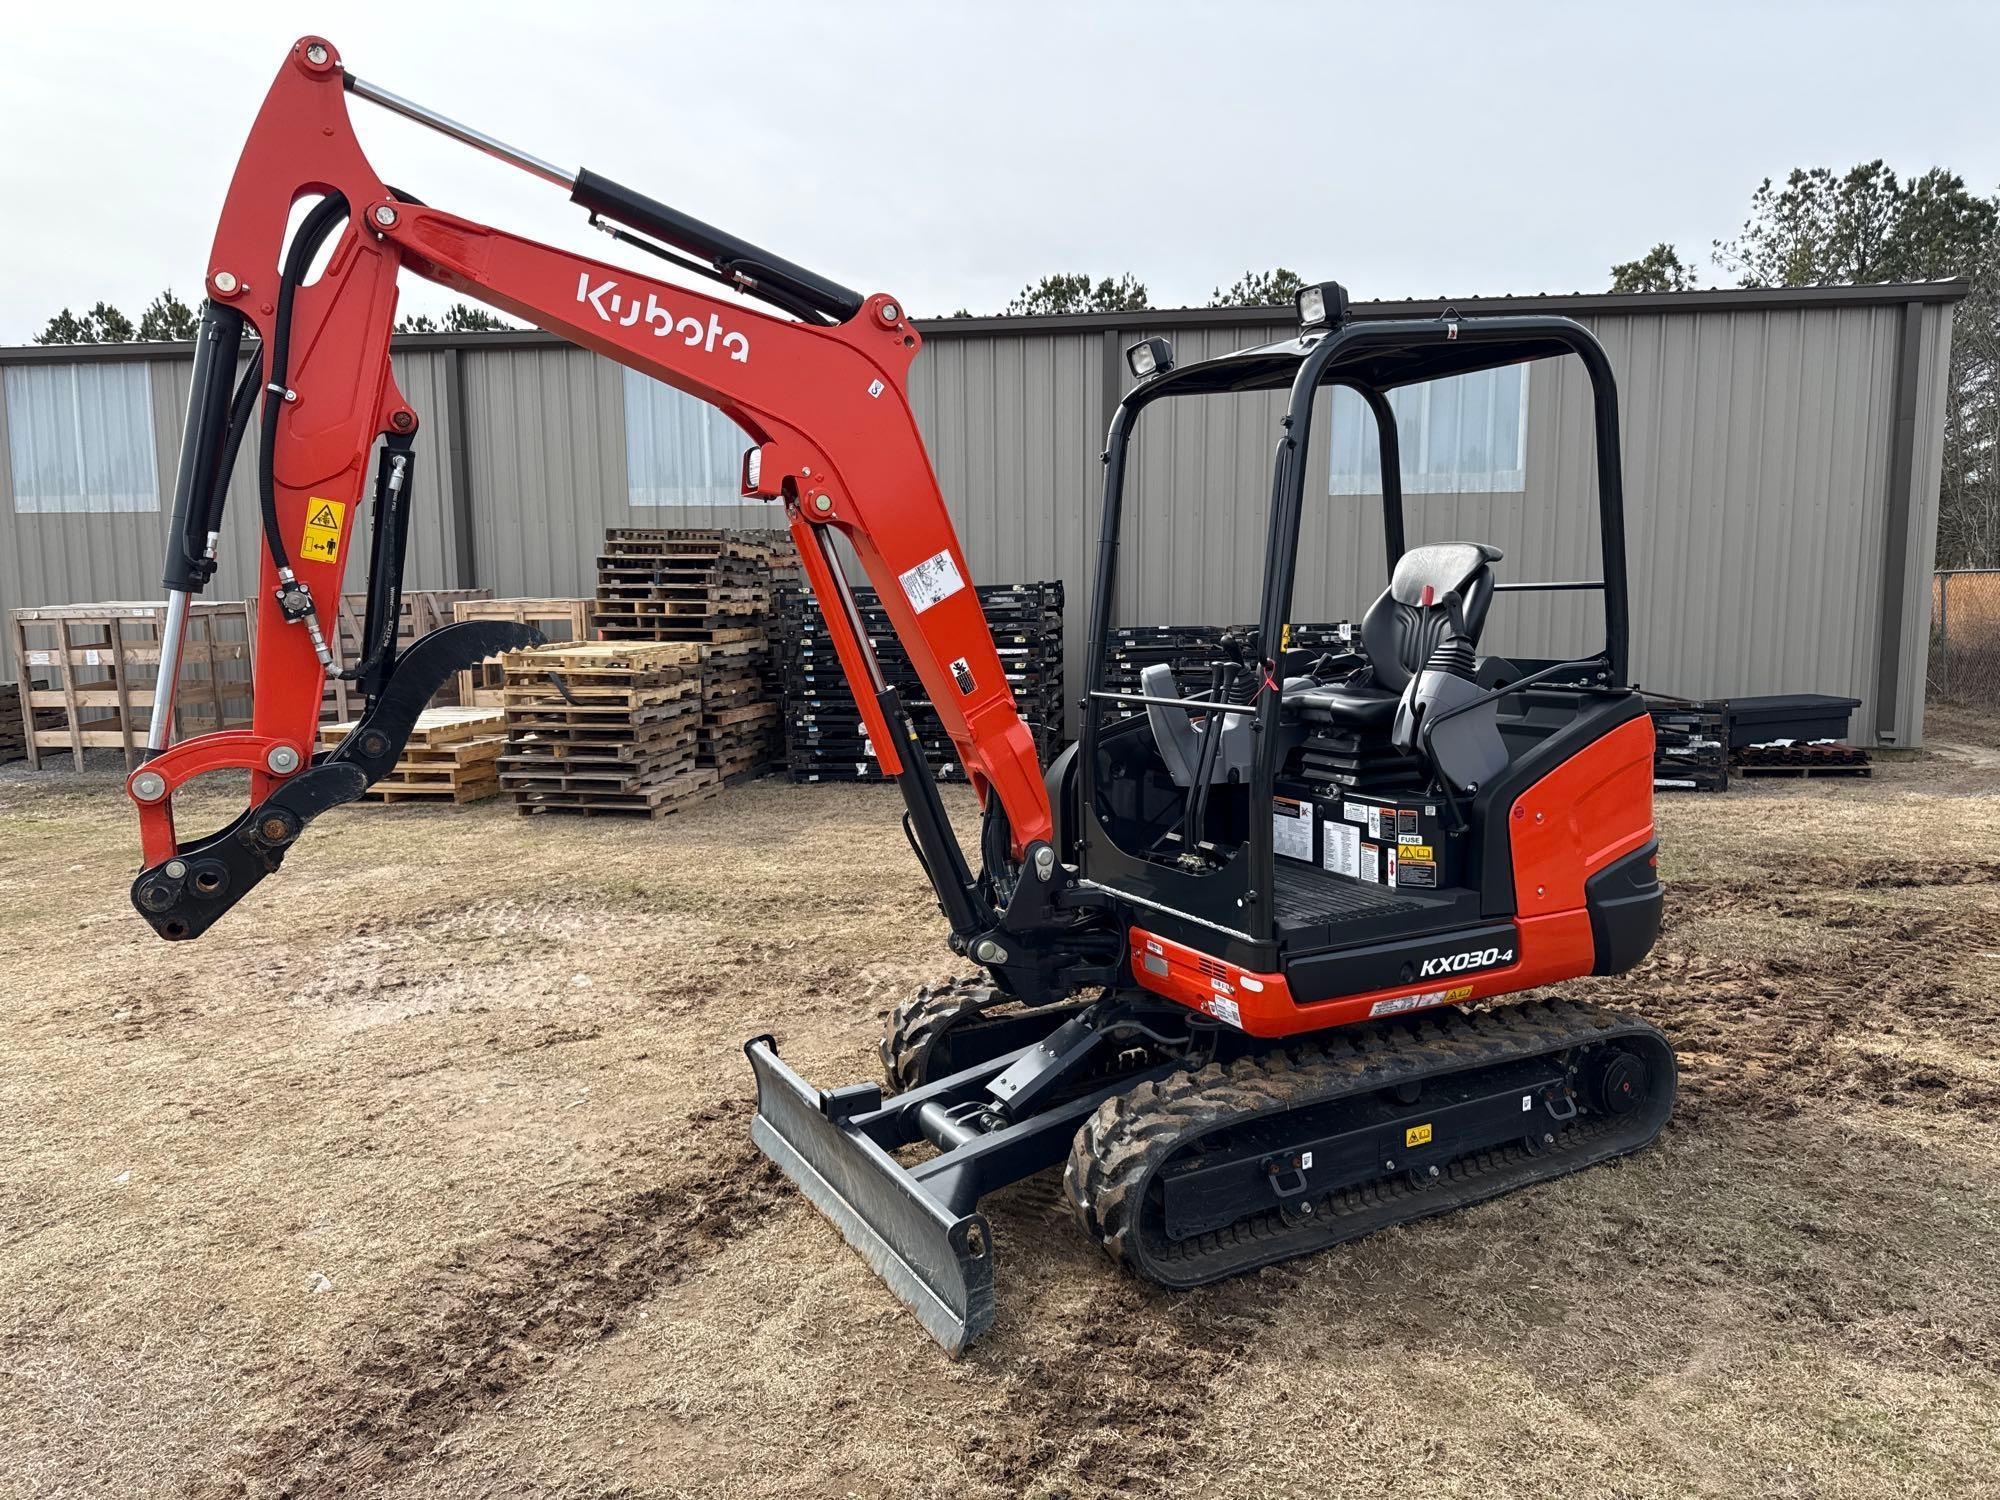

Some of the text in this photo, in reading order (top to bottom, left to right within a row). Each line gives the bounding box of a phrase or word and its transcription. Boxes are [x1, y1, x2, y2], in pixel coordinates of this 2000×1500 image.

[576, 272, 750, 363] Kubota
[1400, 836, 1420, 844] FUSE
[1420, 948, 1513, 977] KX030-4
